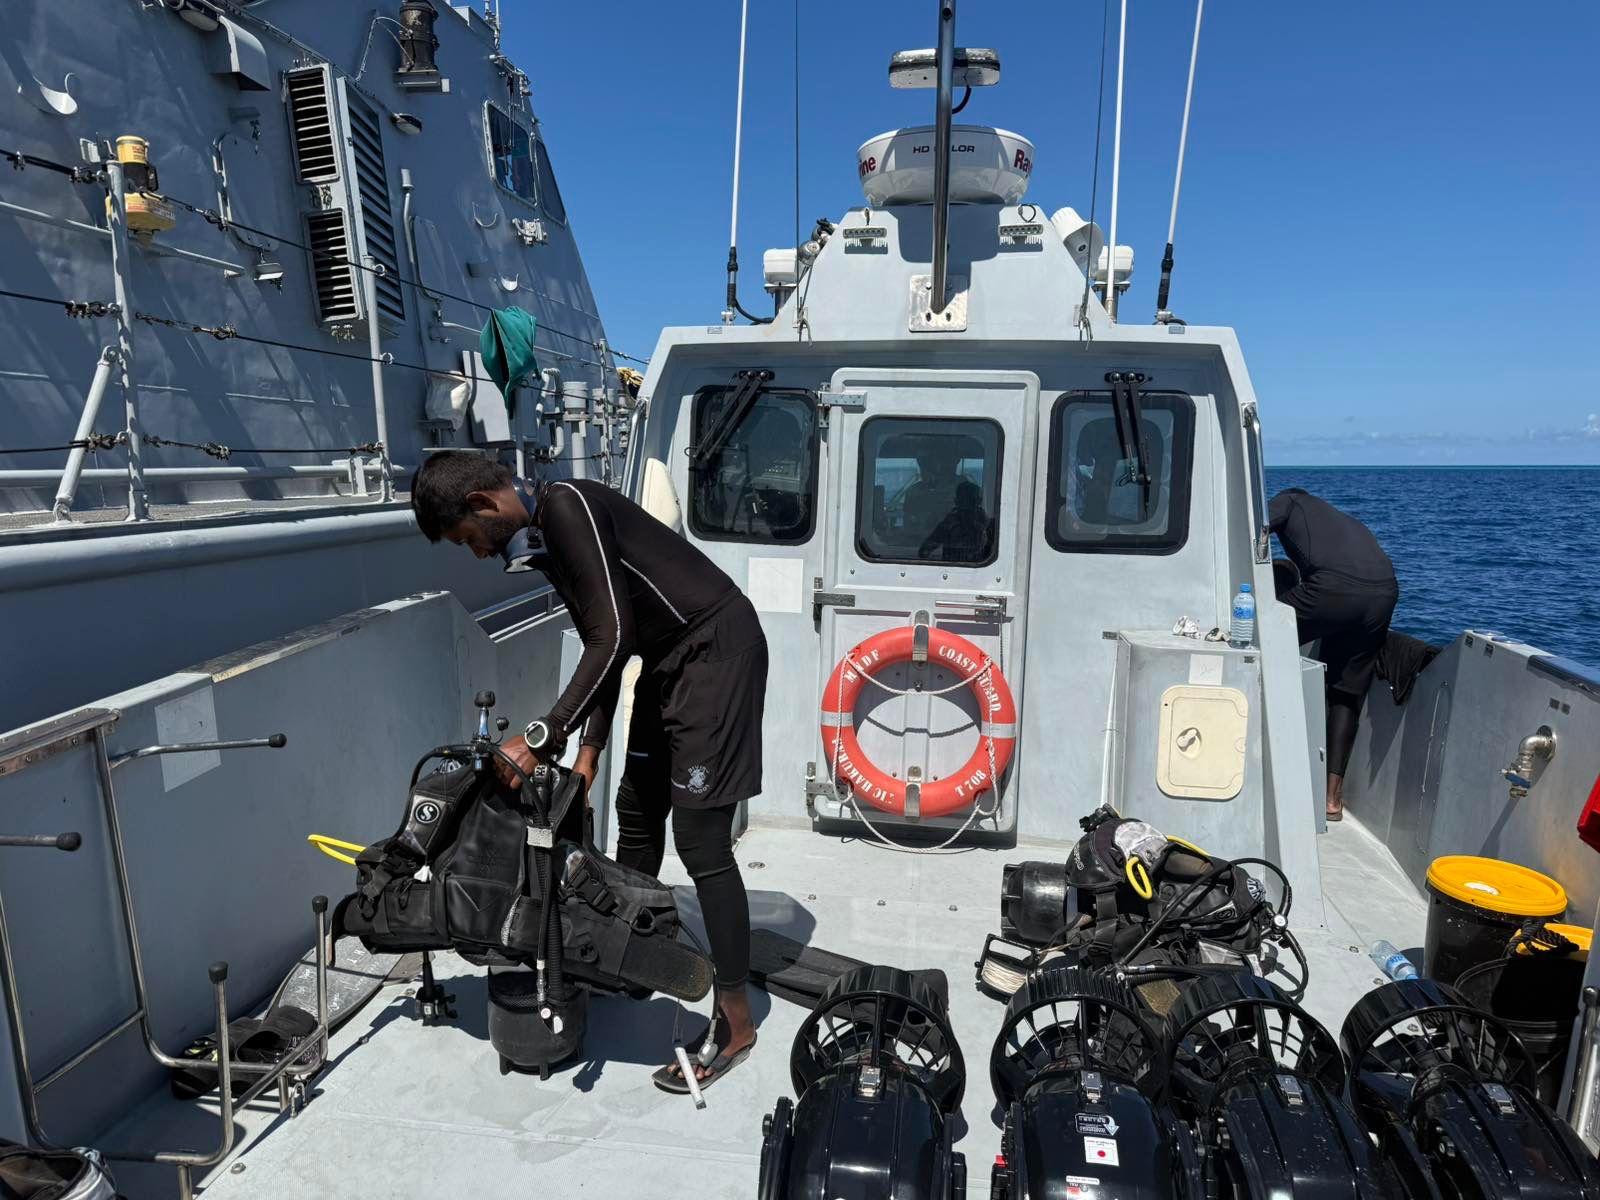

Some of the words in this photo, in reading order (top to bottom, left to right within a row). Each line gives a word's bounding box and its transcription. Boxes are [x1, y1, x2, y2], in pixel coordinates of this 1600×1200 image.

[912, 145, 930, 154] HD
[933, 144, 975, 153] LOR
[938, 645, 978, 672] COAST
[964, 769, 987, 791] 708
